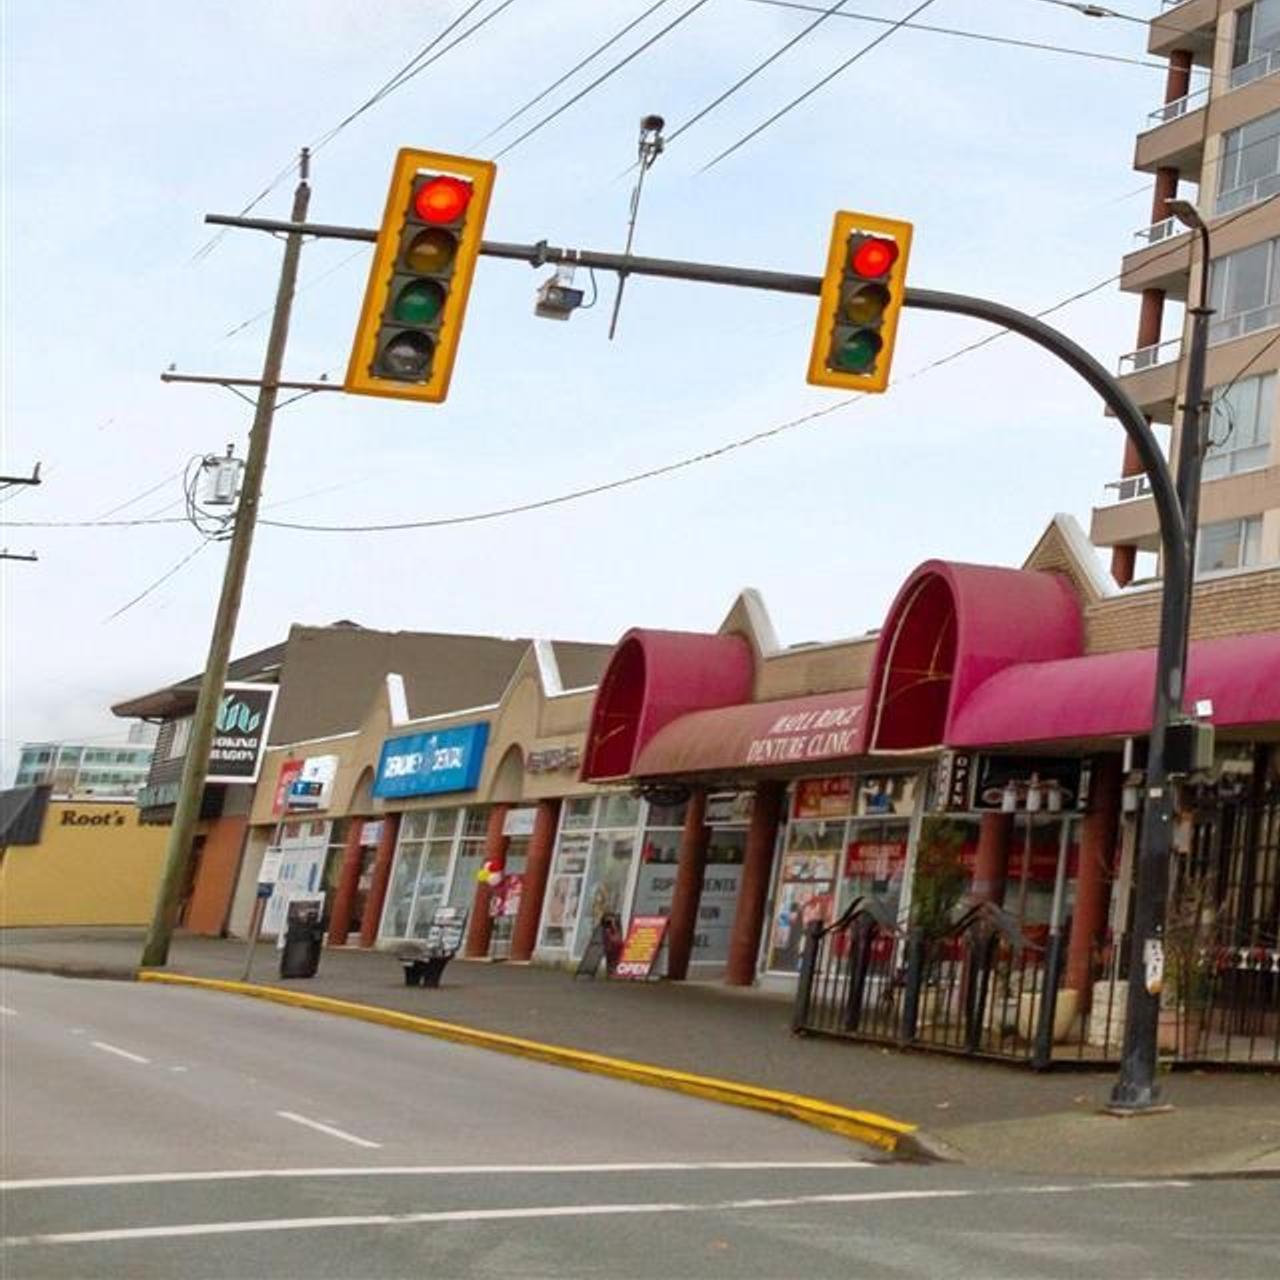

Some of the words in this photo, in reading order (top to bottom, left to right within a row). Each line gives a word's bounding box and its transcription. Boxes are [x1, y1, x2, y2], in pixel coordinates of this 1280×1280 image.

[211, 736, 258, 749] OKING
[745, 735, 805, 763] DENTURE
[805, 728, 859, 757] CLINIC
[208, 749, 255, 761] RAGON
[951, 755, 969, 806] OPEN
[61, 809, 125, 826] Root's
[616, 961, 651, 976] OPEN
